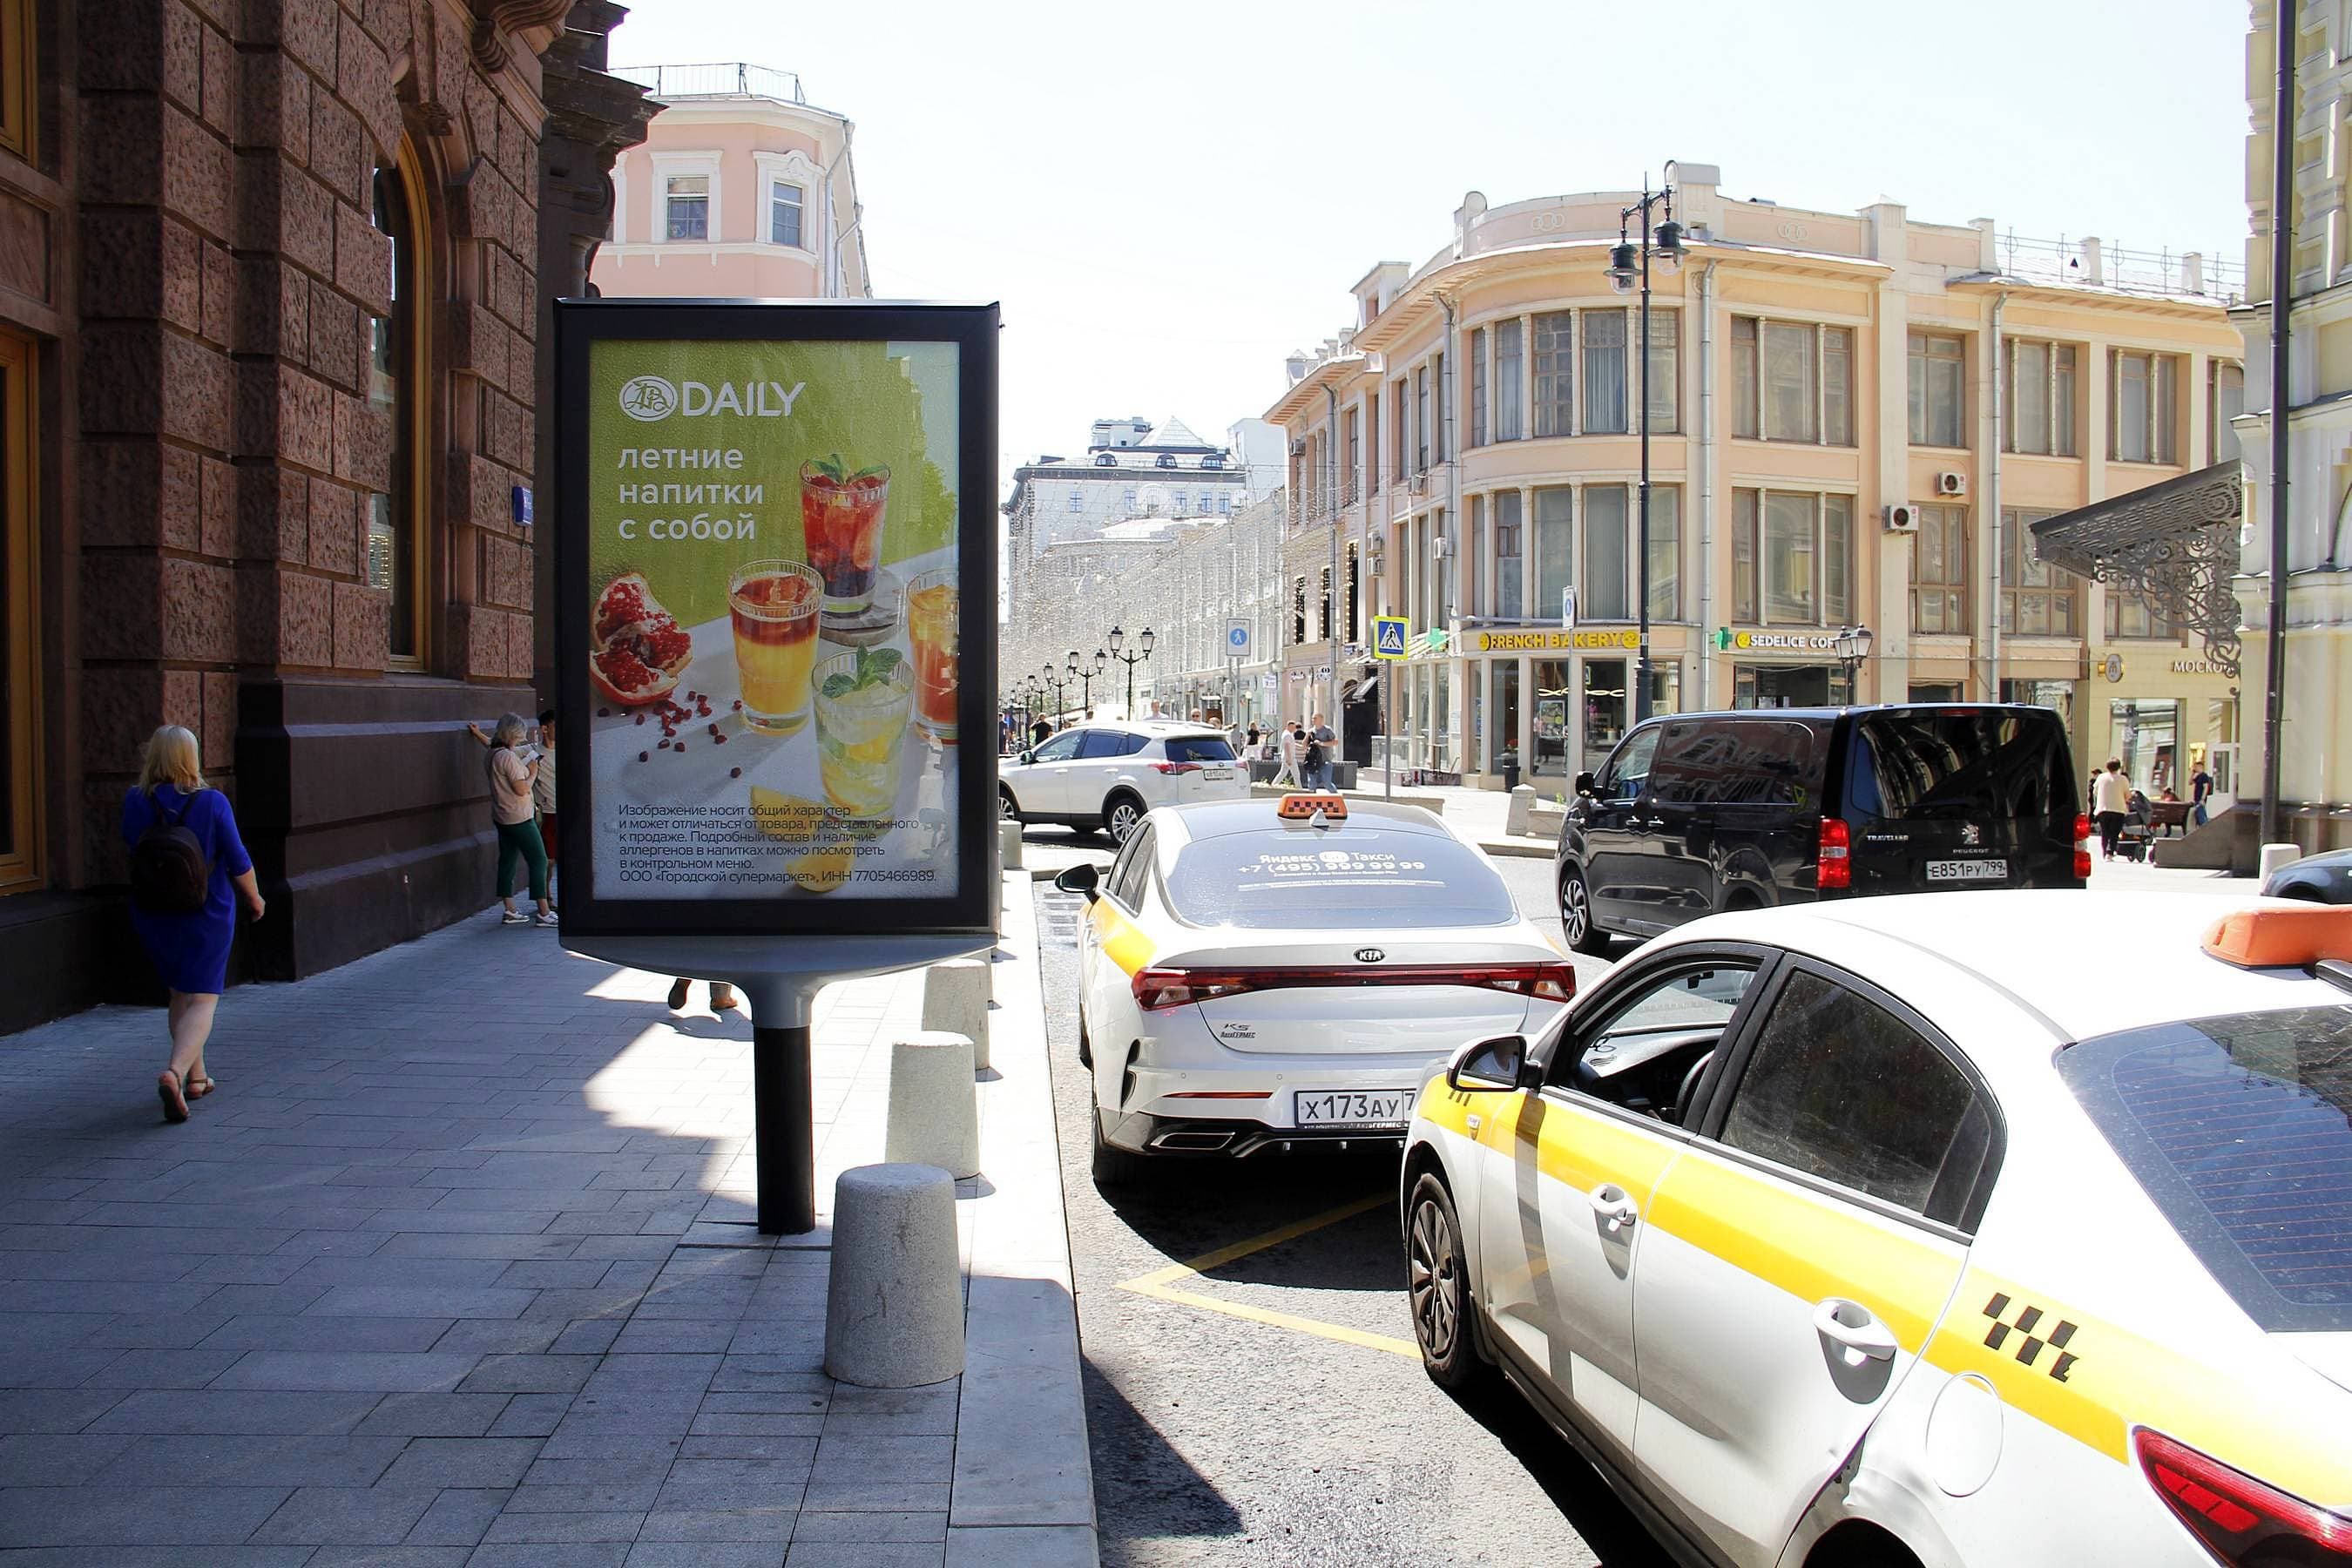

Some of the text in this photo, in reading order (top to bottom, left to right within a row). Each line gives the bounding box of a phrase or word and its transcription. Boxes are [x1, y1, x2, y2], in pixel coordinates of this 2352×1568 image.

[682, 381, 806, 416] DAILY
[618, 448, 744, 470] летние
[619, 483, 763, 504] напитки
[618, 512, 755, 540] с собой
[1490, 632, 1623, 649] FRENCH BAKERY
[1750, 635, 1806, 648] SEDELICE
[618, 804, 851, 818] Изображение носит общий характер
[619, 820, 627, 828] и
[630, 820, 670, 828] может
[672, 819, 741, 828] отличаться
[744, 819, 757, 828] от
[760, 819, 807, 831] товара,
[619, 831, 876, 845] к продаже. Подробный состав и наличие
[619, 845, 885, 858] аллергенов в напитках можно посмотреть
[1260, 855, 1317, 865] Яндекс
[1351, 852, 1396, 862] Такси
[630, 860, 713, 871] контрольном
[716, 859, 754, 869] меню.
[1238, 860, 1426, 873] +7 (495) 999 99 99
[1984, 861, 2004, 872] 799
[619, 869, 937, 884] ООО «Городской супермаркет», ИНН 7705466989.
[1359, 950, 1382, 961] KIA
[1404, 1092, 1416, 1111] 7
